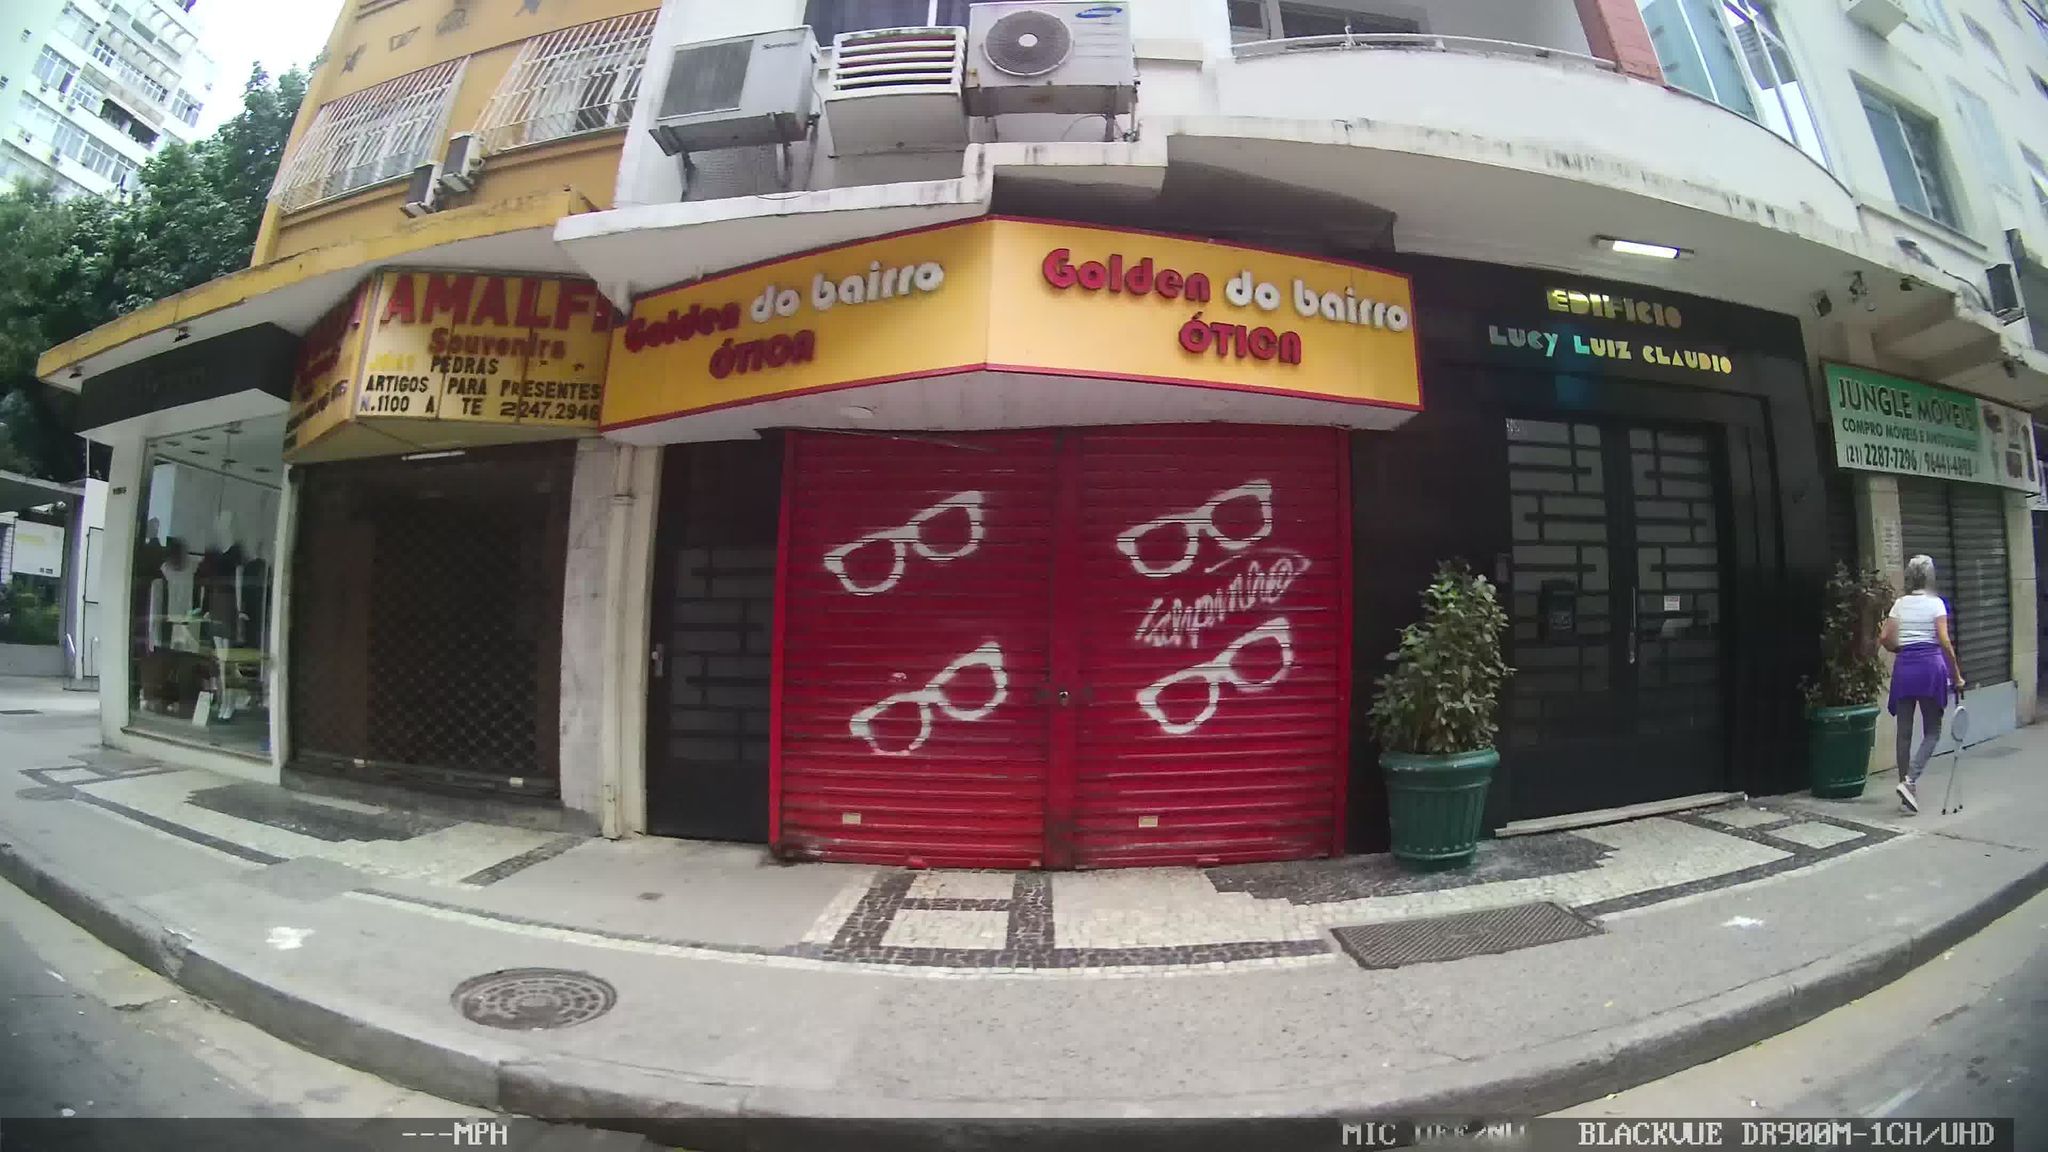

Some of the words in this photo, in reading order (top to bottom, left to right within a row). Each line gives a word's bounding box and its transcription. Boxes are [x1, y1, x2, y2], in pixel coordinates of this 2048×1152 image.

[624, 301, 741, 354] Golden
[750, 285, 801, 323] do
[811, 259, 946, 311] bairro
[1042, 248, 1211, 303] Golden
[1225, 269, 1281, 311] do
[1293, 278, 1410, 333] bairro
[1546, 288, 1683, 330] EDIFICIO
[708, 329, 816, 380] ÓTICA
[1178, 311, 1303, 367] ÓTICA
[1573, 335, 1633, 361] LUIZ
[1642, 345, 1733, 375] CLAUDIO
[366, 375, 430, 394] ARTIGOS
[447, 377, 488, 396] PARA
[430, 355, 499, 376] PEDRAS
[1839, 378, 1913, 419] JUNGLE
[1842, 417, 1884, 438] COMPRO
